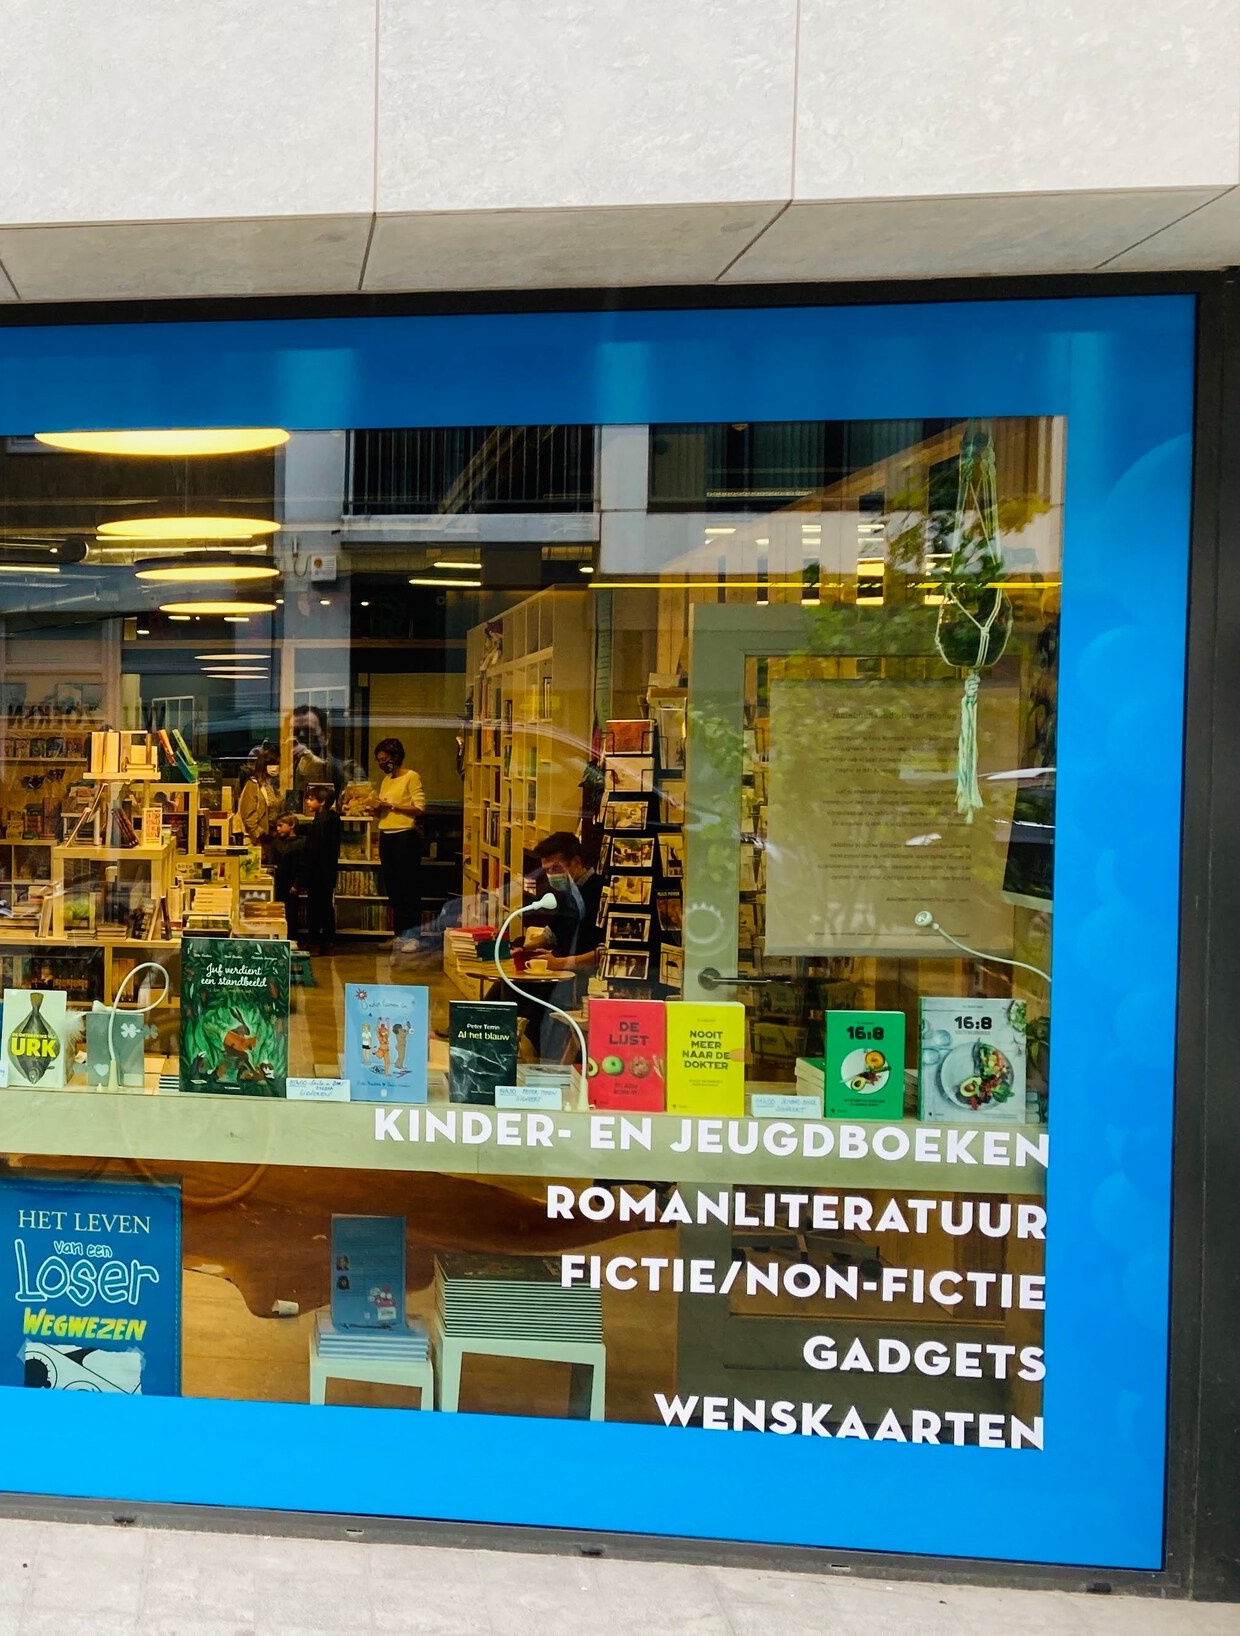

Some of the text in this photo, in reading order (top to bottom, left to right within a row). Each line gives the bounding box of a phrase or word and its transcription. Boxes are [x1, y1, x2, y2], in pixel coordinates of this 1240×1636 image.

[206, 963, 262, 978] Juf verdient
[218, 977, 267, 988] standbeeld
[619, 1022, 639, 1033] DE
[954, 1016, 992, 1030] 16:8
[458, 1031, 510, 1041] Al het blauw
[609, 1034, 649, 1046] LIJST
[689, 1030, 724, 1039] NOOIT
[846, 1026, 884, 1041] 16:8
[11, 1037, 57, 1058] URK
[691, 1040, 722, 1049] MEER
[682, 1050, 731, 1060] NAAR DE
[684, 1060, 728, 1070] DOKTER
[374, 1107, 1049, 1168] KINDER- EN JEUGDBOEKEN
[546, 1185, 1047, 1239] ROMANLITERATUUR
[18, 1209, 151, 1234] HET LEVEN
[53, 1240, 113, 1258] van een
[14, 1238, 160, 1307] Loser
[561, 1254, 1046, 1310] FICTIE/NON-FICTIE
[23, 1307, 147, 1341] WEGWEZEN
[802, 1335, 1047, 1382] GADGETS
[653, 1393, 1044, 1451] WENSKAARTEN
